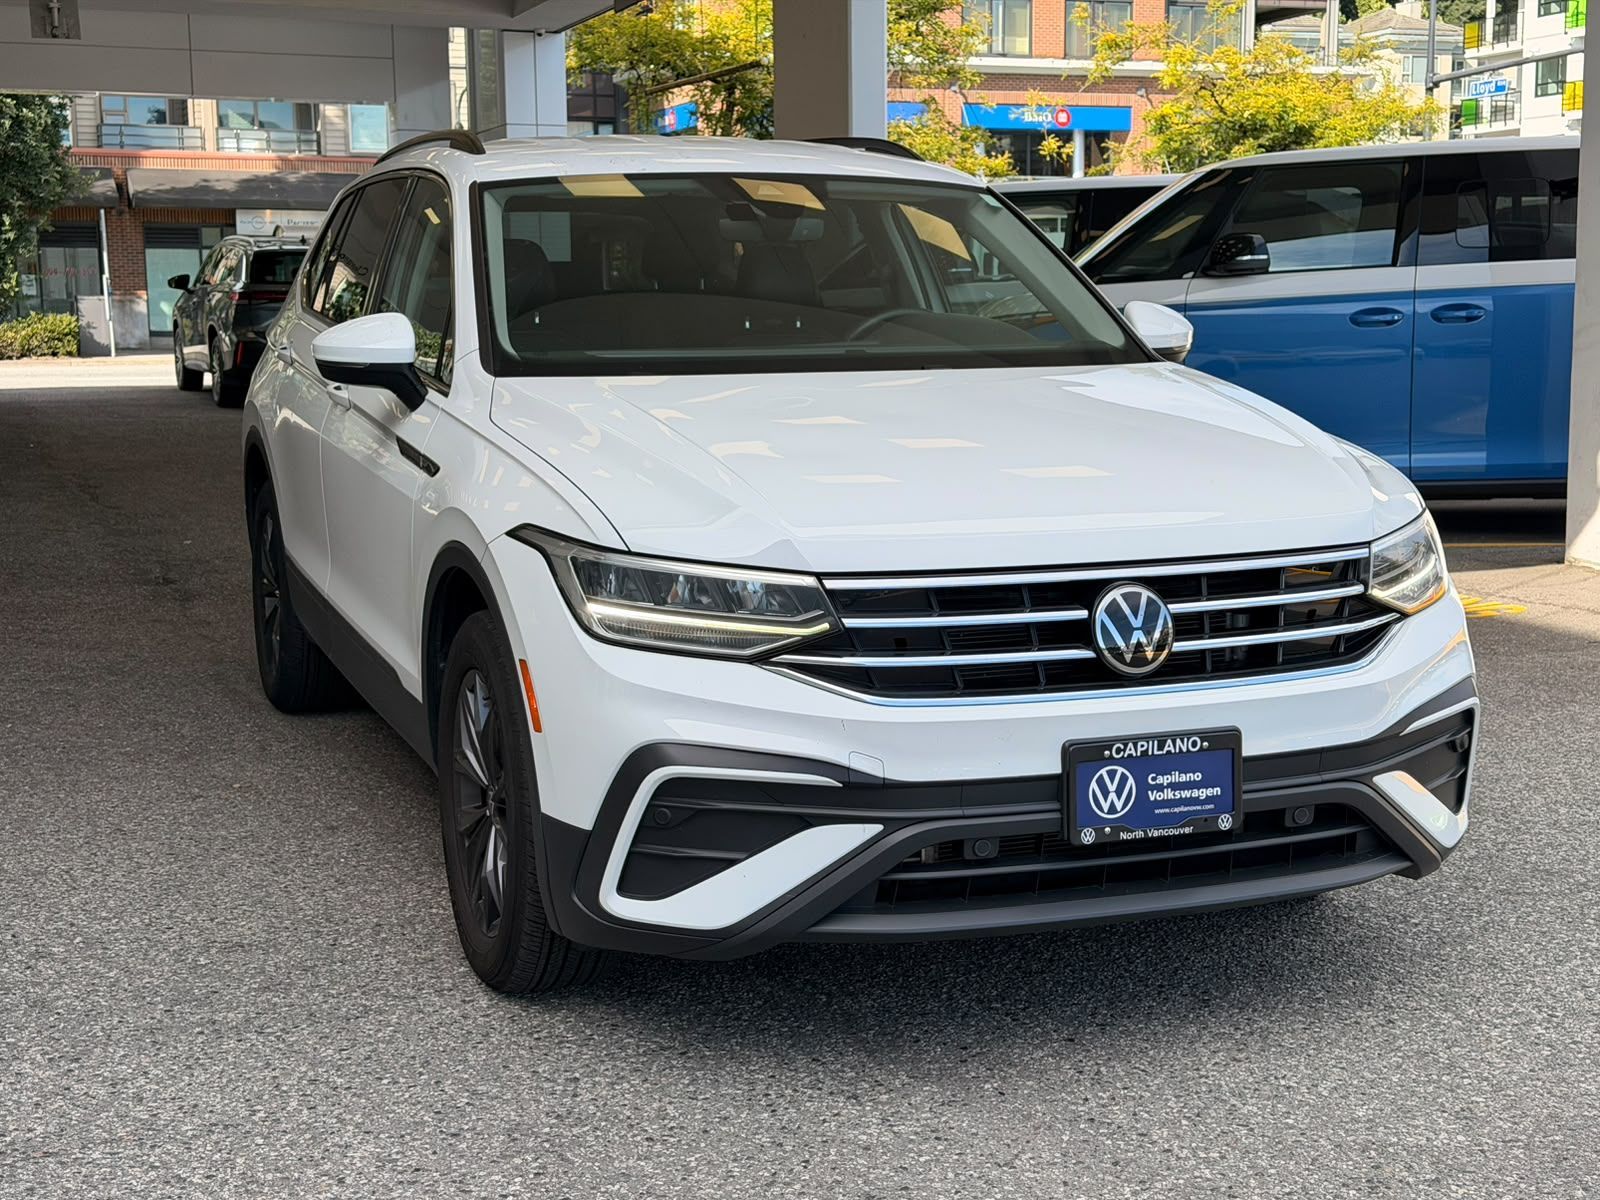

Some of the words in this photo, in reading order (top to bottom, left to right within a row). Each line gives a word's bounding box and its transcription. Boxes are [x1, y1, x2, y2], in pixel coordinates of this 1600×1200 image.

[1472, 80, 1496, 97] Lloyd
[1112, 736, 1201, 759] CAPILANO
[1148, 771, 1202, 788] Capilano
[1148, 786, 1221, 801] Volkswagen
[1154, 803, 1215, 815] www.capilanovw.com
[1120, 829, 1144, 841] North
[1147, 825, 1194, 838] Vancouver
